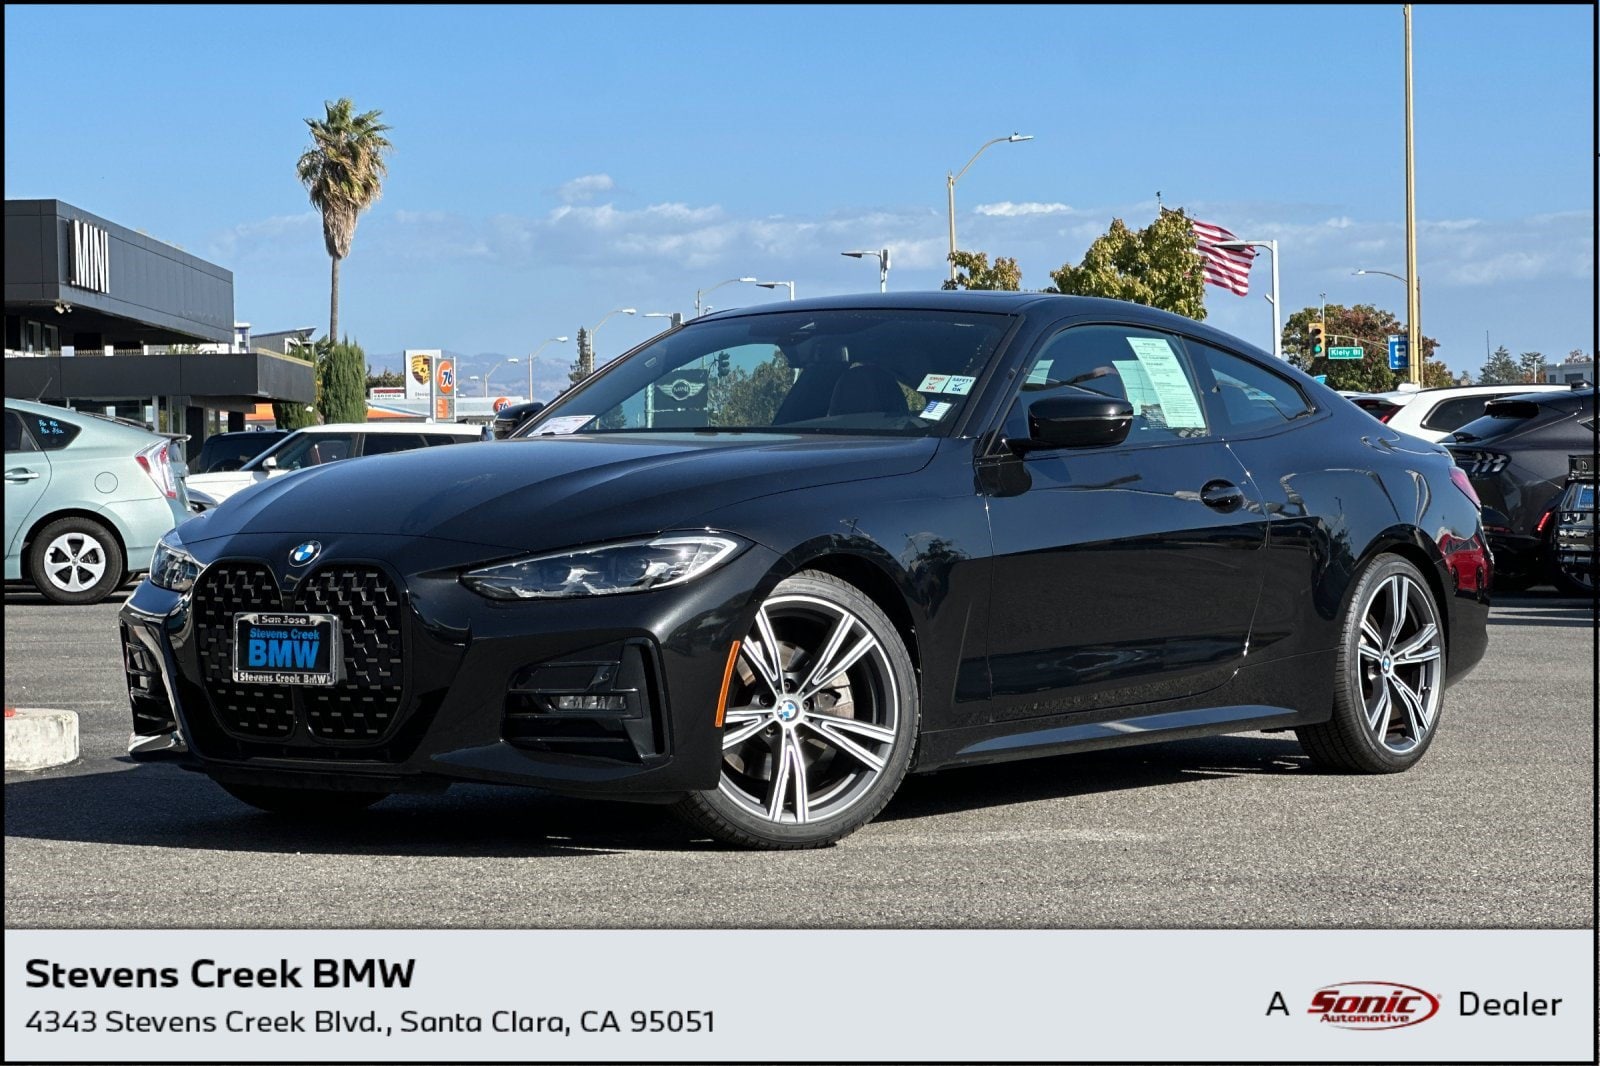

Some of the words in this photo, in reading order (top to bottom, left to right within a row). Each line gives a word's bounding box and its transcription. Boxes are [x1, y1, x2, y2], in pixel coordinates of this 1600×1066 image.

[74, 219, 110, 294] MINI
[442, 369, 453, 386] 76
[261, 615, 281, 624] San
[283, 615, 307, 625] Jose
[249, 628, 288, 639] Stevens
[290, 628, 320, 640] Creek
[248, 639, 320, 669] BMW
[240, 672, 273, 682] Stevens
[275, 673, 300, 683] Creek
[303, 674, 327, 684] BMW
